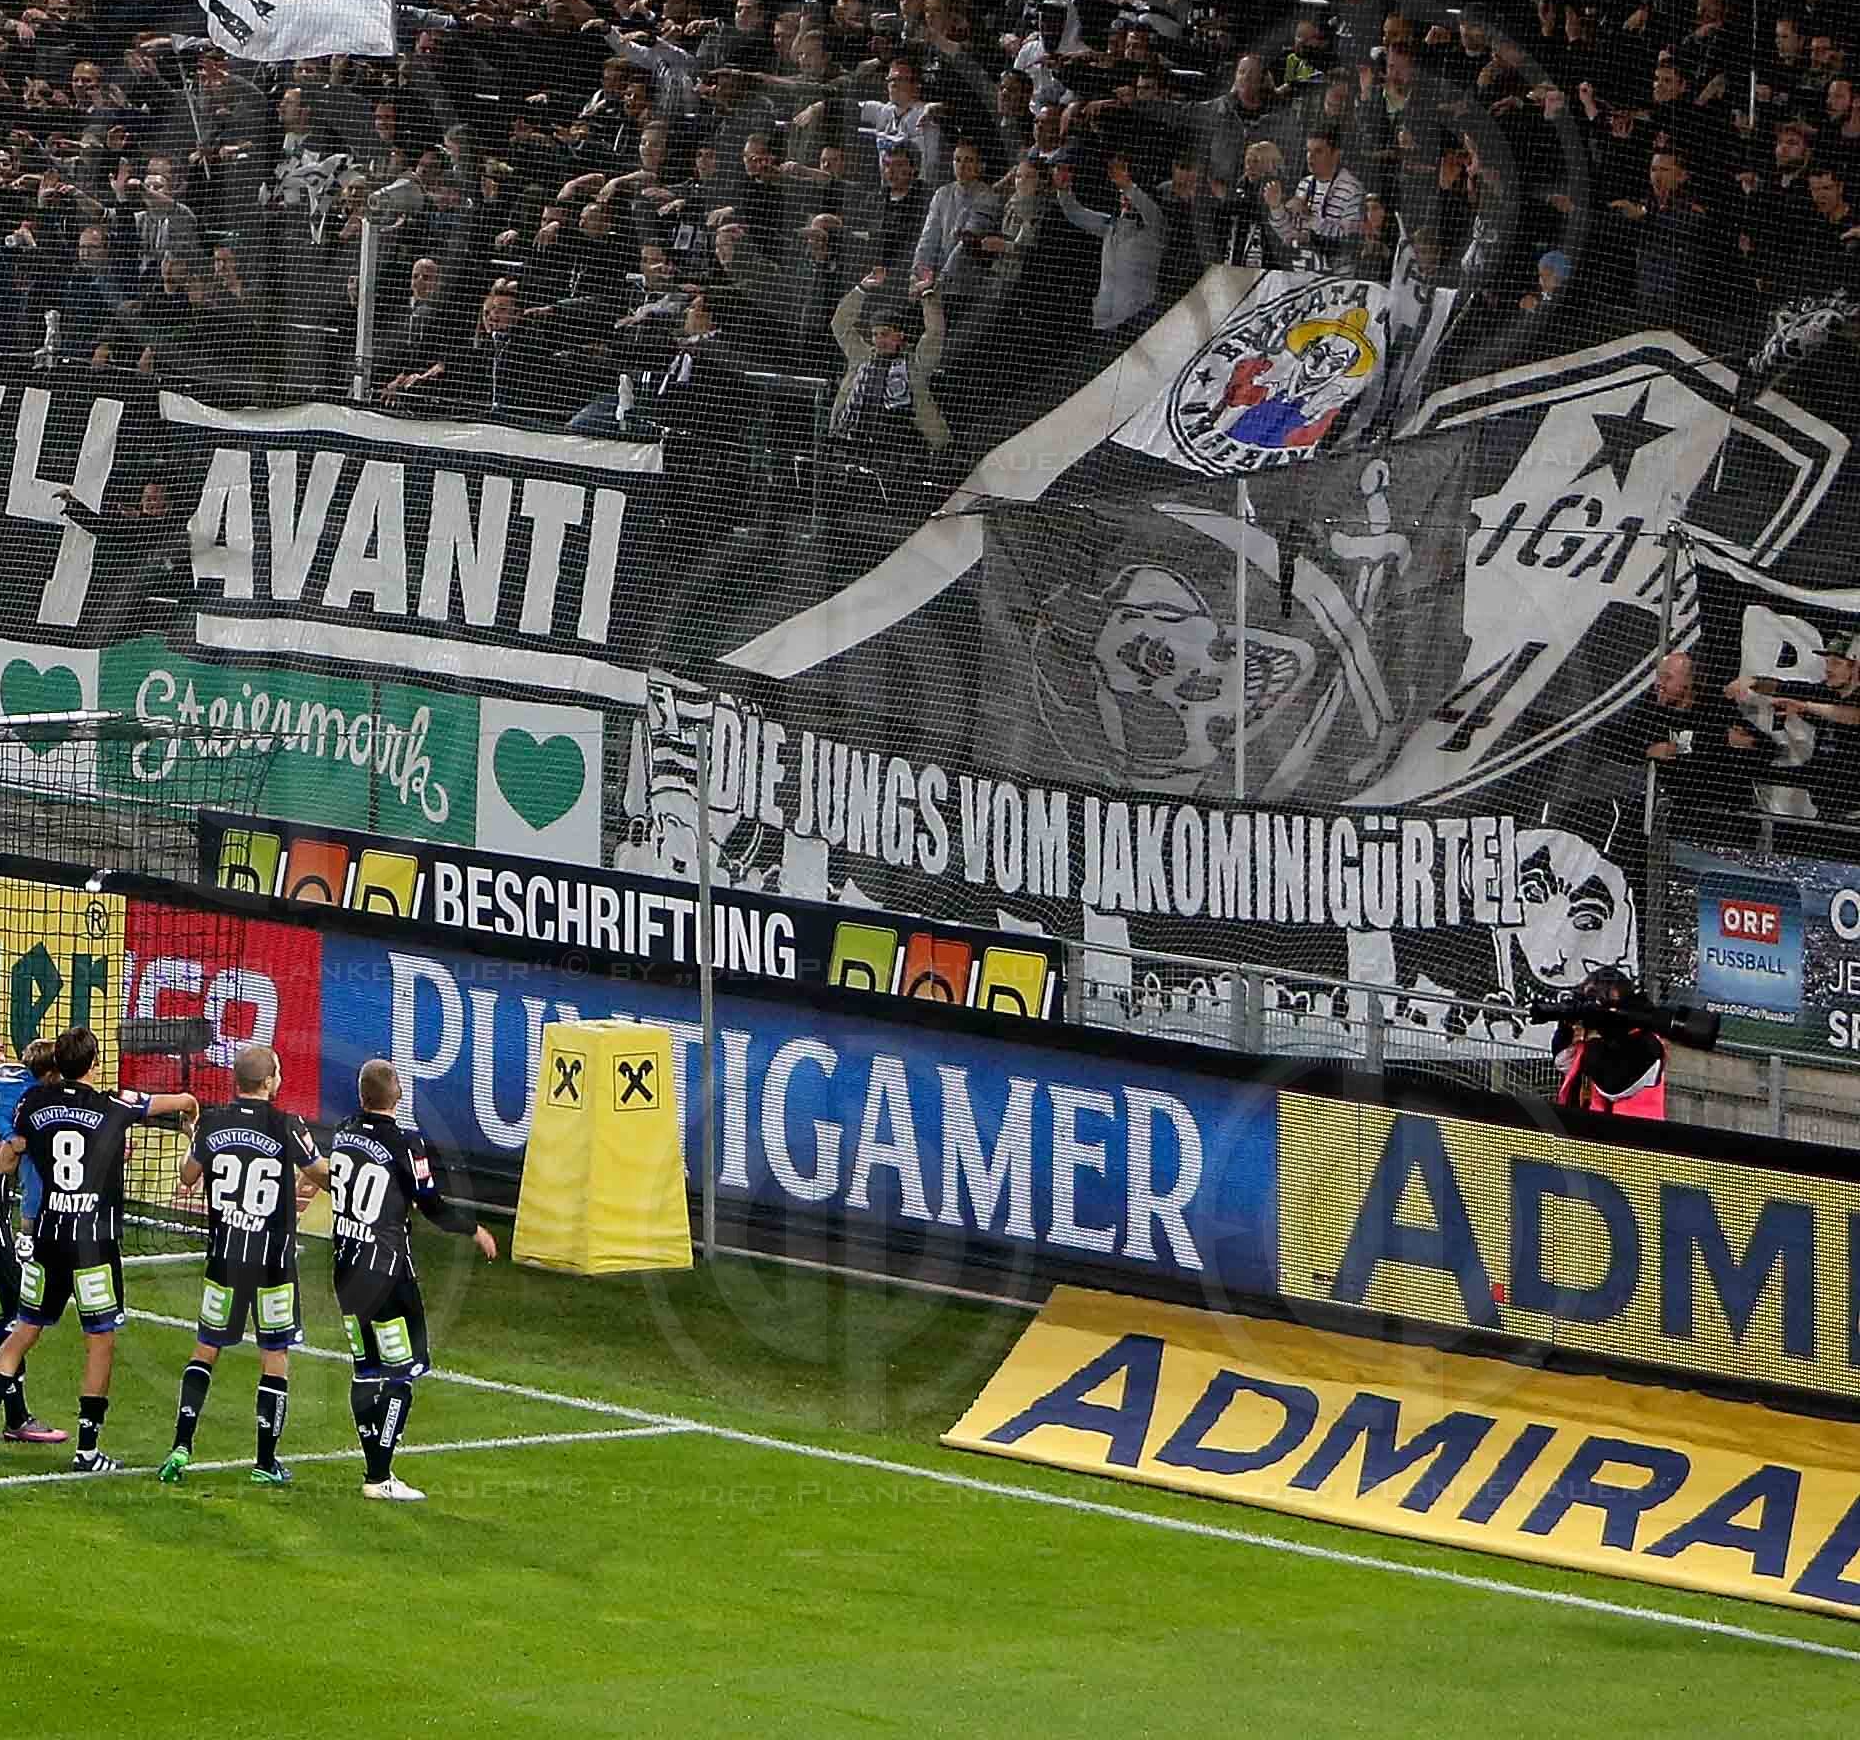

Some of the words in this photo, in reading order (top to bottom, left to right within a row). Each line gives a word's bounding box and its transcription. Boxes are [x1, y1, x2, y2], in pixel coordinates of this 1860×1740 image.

[187, 447, 627, 646] AVANTI
[711, 700, 787, 829] DIE
[794, 729, 952, 876] JUNGS
[958, 774, 1071, 898] VOM
[434, 860, 797, 982] BESCHRIFTUNG
[1723, 907, 1776, 936] ORF
[1706, 947, 1788, 975] FUSSBALL
[209, 1129, 278, 1155] PUNTIGAMER
[387, 948, 1205, 1272] PUIGAMER
[51, 1129, 86, 1192] 8
[211, 1153, 283, 1217] 26
[330, 1150, 391, 1225] 30
[48, 1191, 99, 1214] MATIC
